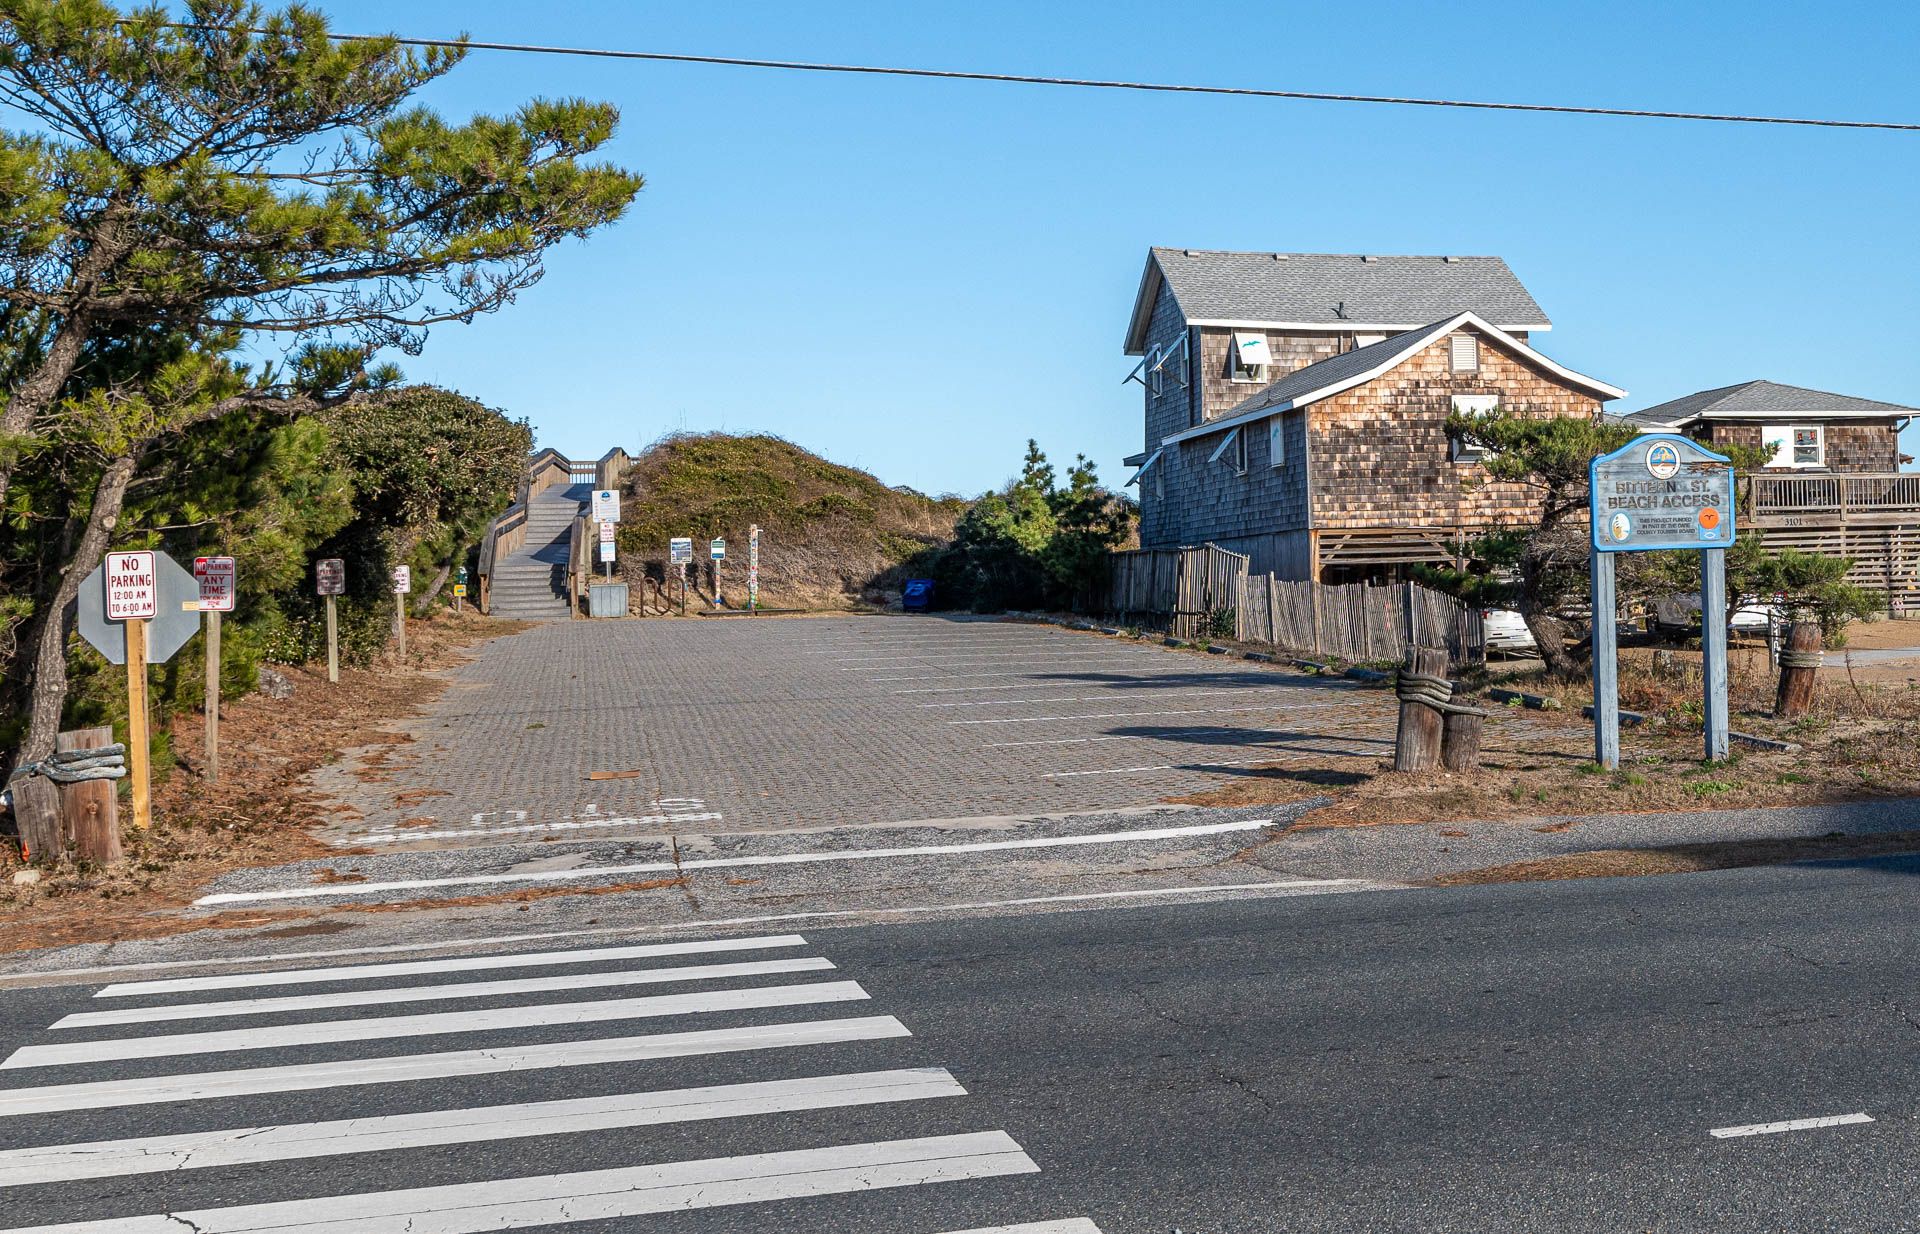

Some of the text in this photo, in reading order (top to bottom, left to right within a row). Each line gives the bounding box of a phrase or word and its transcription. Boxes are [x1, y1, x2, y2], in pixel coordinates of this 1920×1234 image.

[1615, 480, 1676, 494] BITTERN
[1608, 494, 1720, 509] BEACH ACCESS
[1784, 518, 1803, 526] 3101
[122, 558, 139, 571] NO
[196, 561, 231, 571] NO PARKING
[111, 574, 151, 588] PARKING
[203, 576, 225, 585] ANY
[202, 585, 226, 594] TIME
[114, 590, 147, 600] 12:00 AM
[112, 603, 152, 612] TO 6:00 AM
